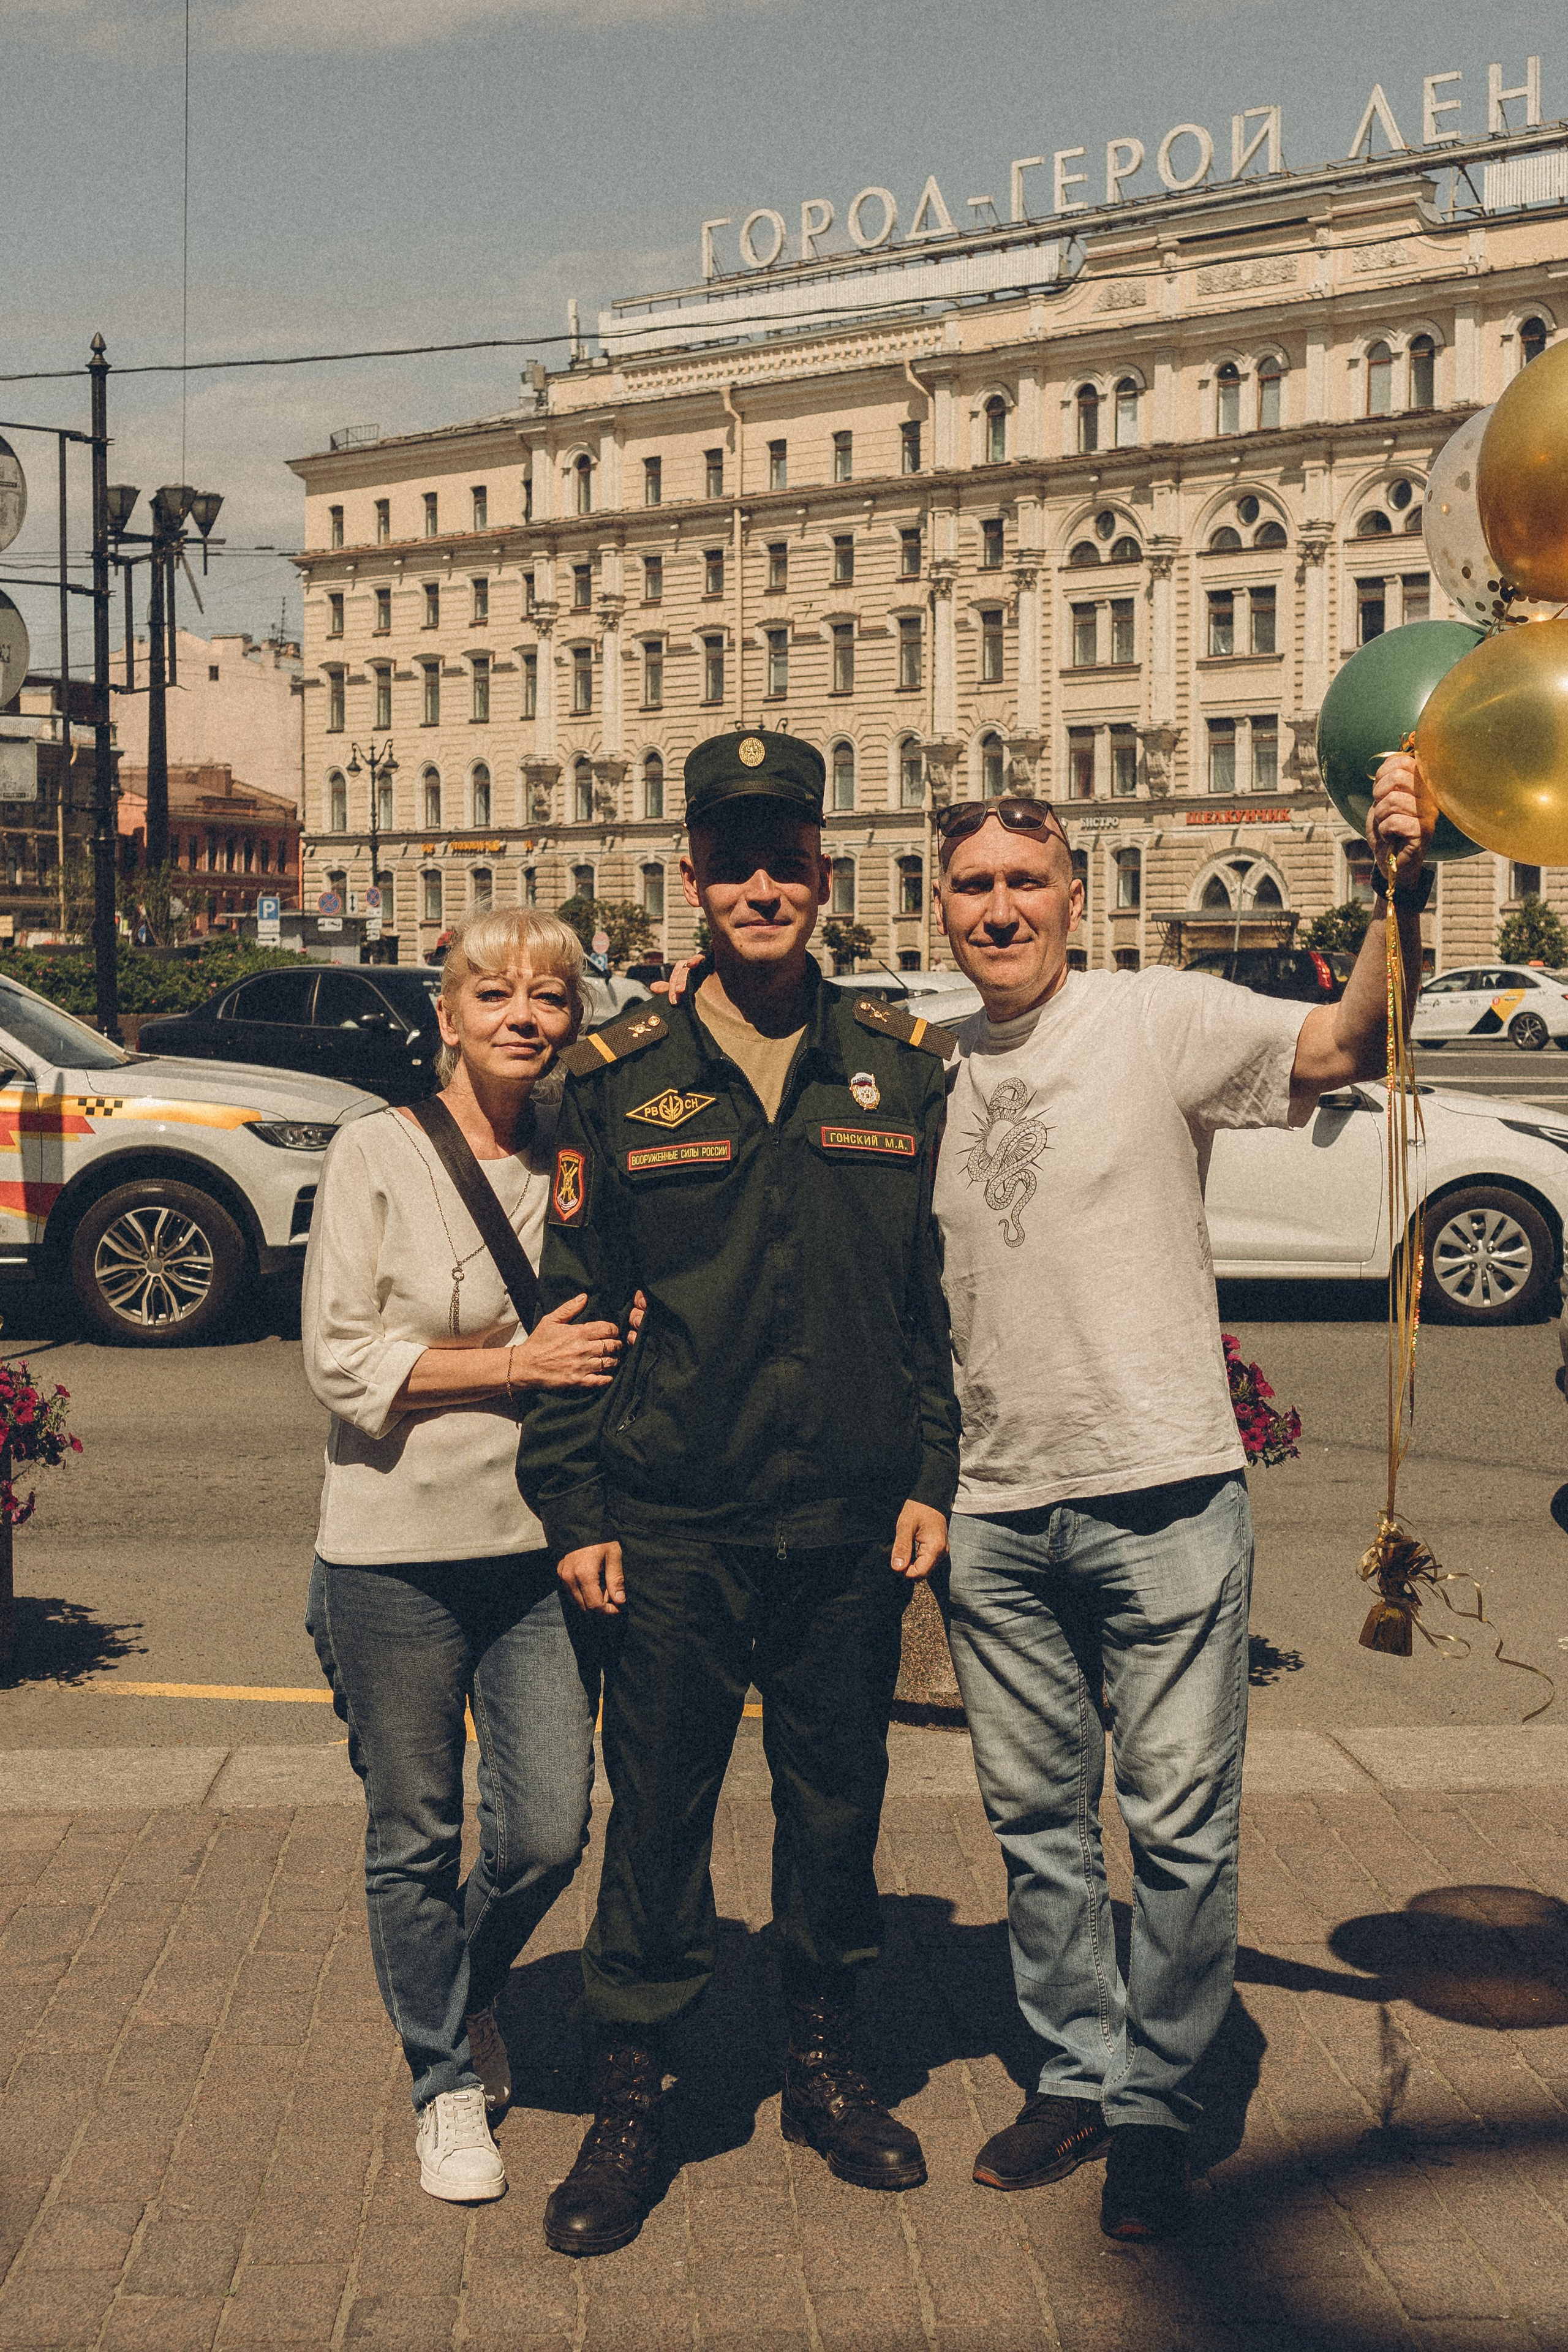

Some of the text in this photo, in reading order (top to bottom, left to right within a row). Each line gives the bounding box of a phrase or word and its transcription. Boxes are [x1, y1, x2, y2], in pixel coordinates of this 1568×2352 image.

[1349, 55, 1542, 159] ЛЕН
[1080, 816, 1120, 828] БИСТРО
[1186, 808, 1291, 825] ЩЕЛКУНЧИК
[830, 1132, 909, 1151] ГОНСКИЙ М.А.
[631, 1145, 728, 1166] ВООРУЖЕННЫЕ СИЛЫ РОССИИ
